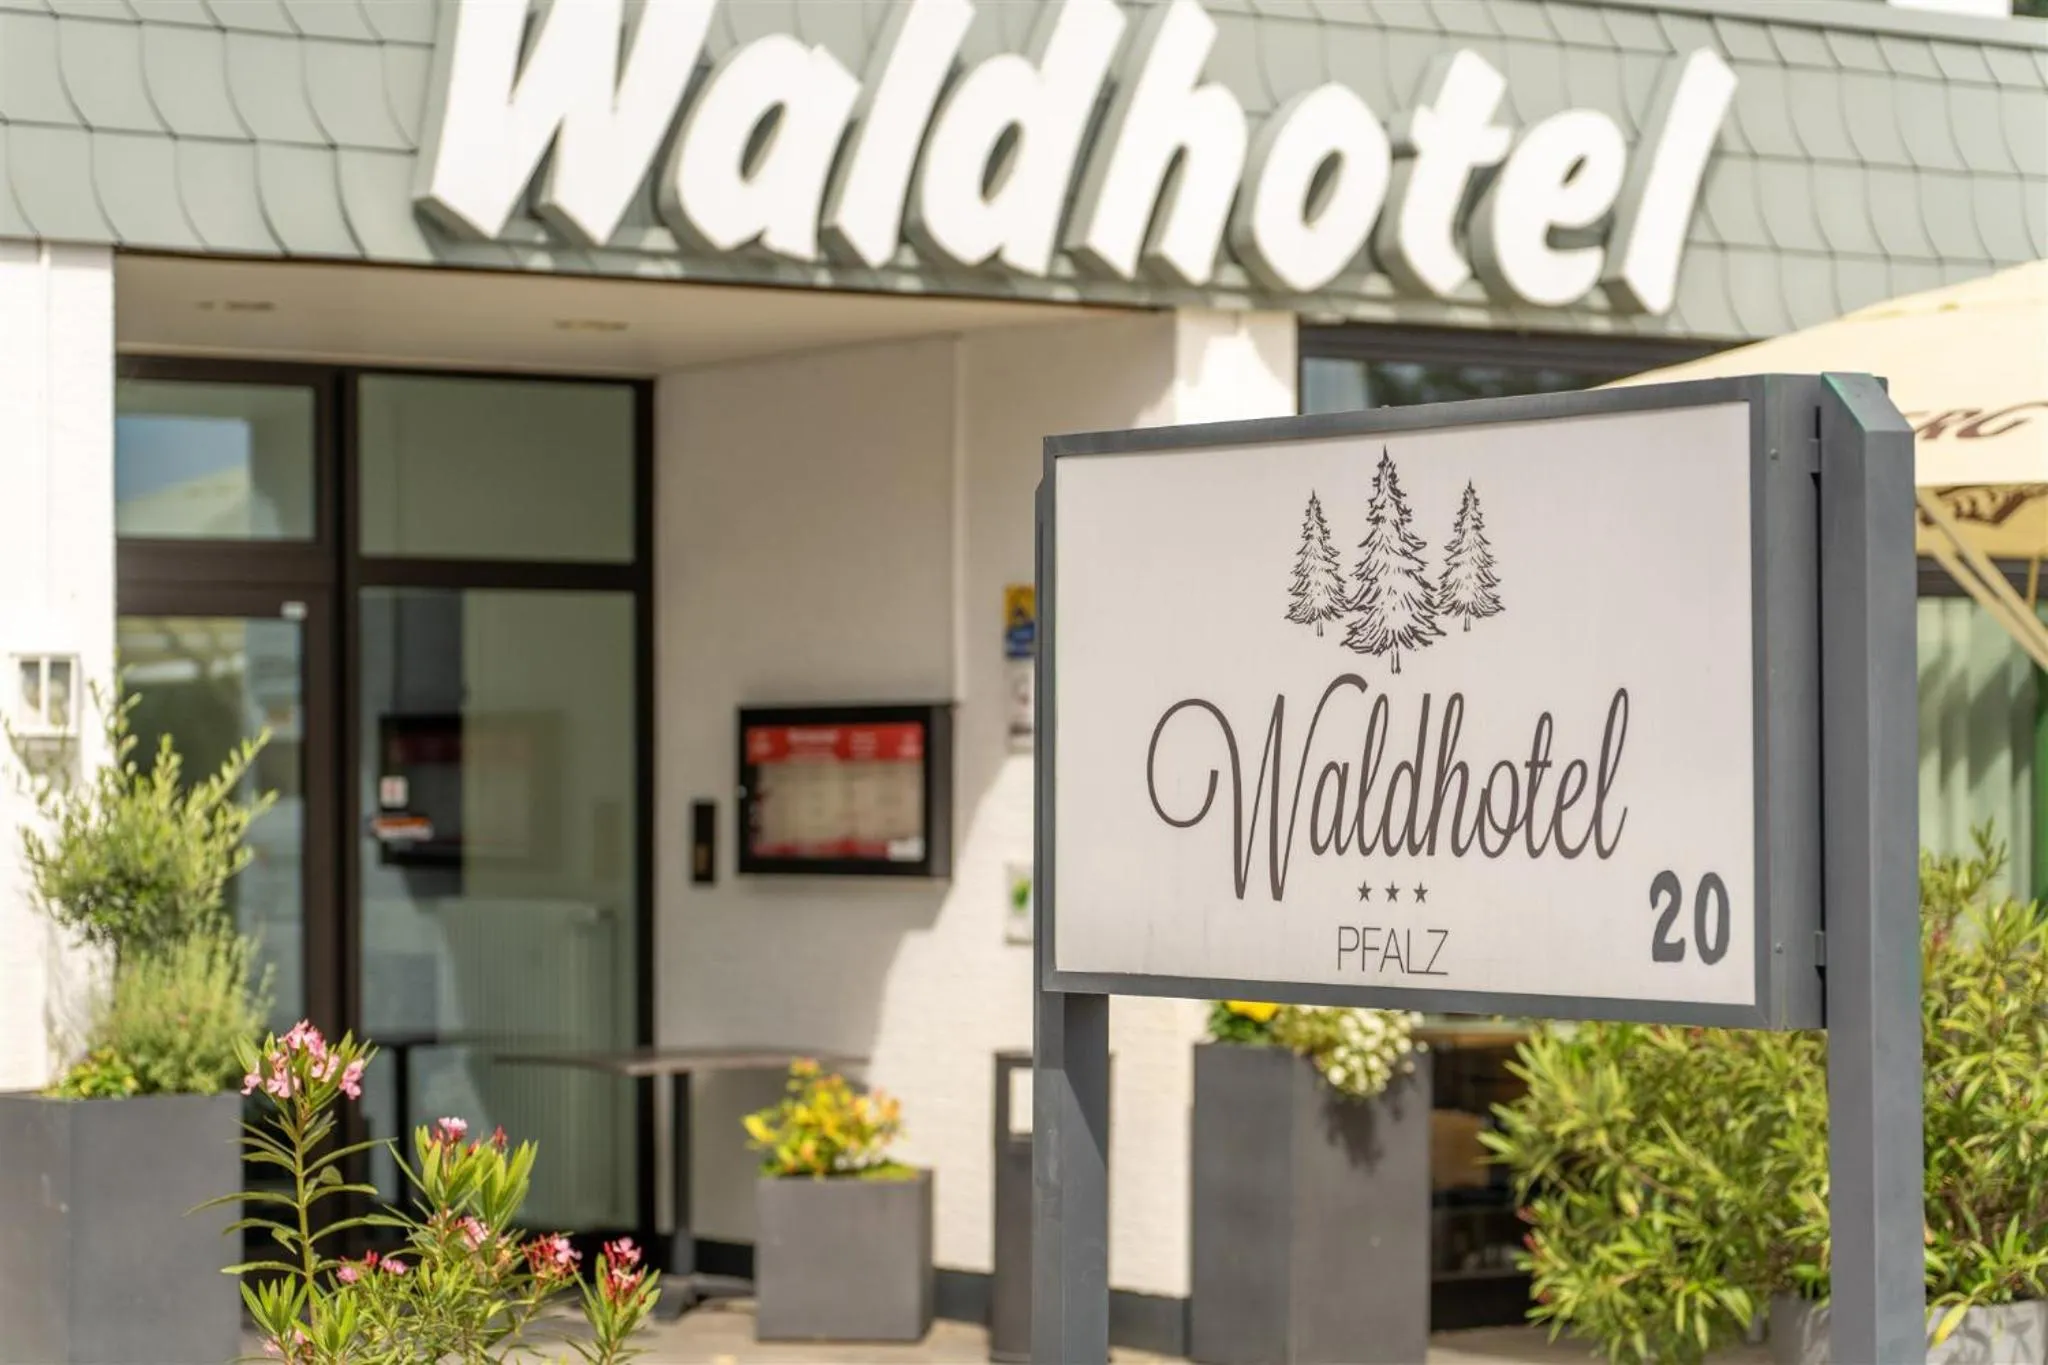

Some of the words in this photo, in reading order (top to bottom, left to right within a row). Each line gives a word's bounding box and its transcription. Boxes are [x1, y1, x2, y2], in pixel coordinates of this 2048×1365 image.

[426, 0, 1738, 316] Waldhotel
[1146, 673, 1629, 902] Waldhotel
[1336, 925, 1449, 976] PFALZ
[1649, 869, 1730, 966] 20
